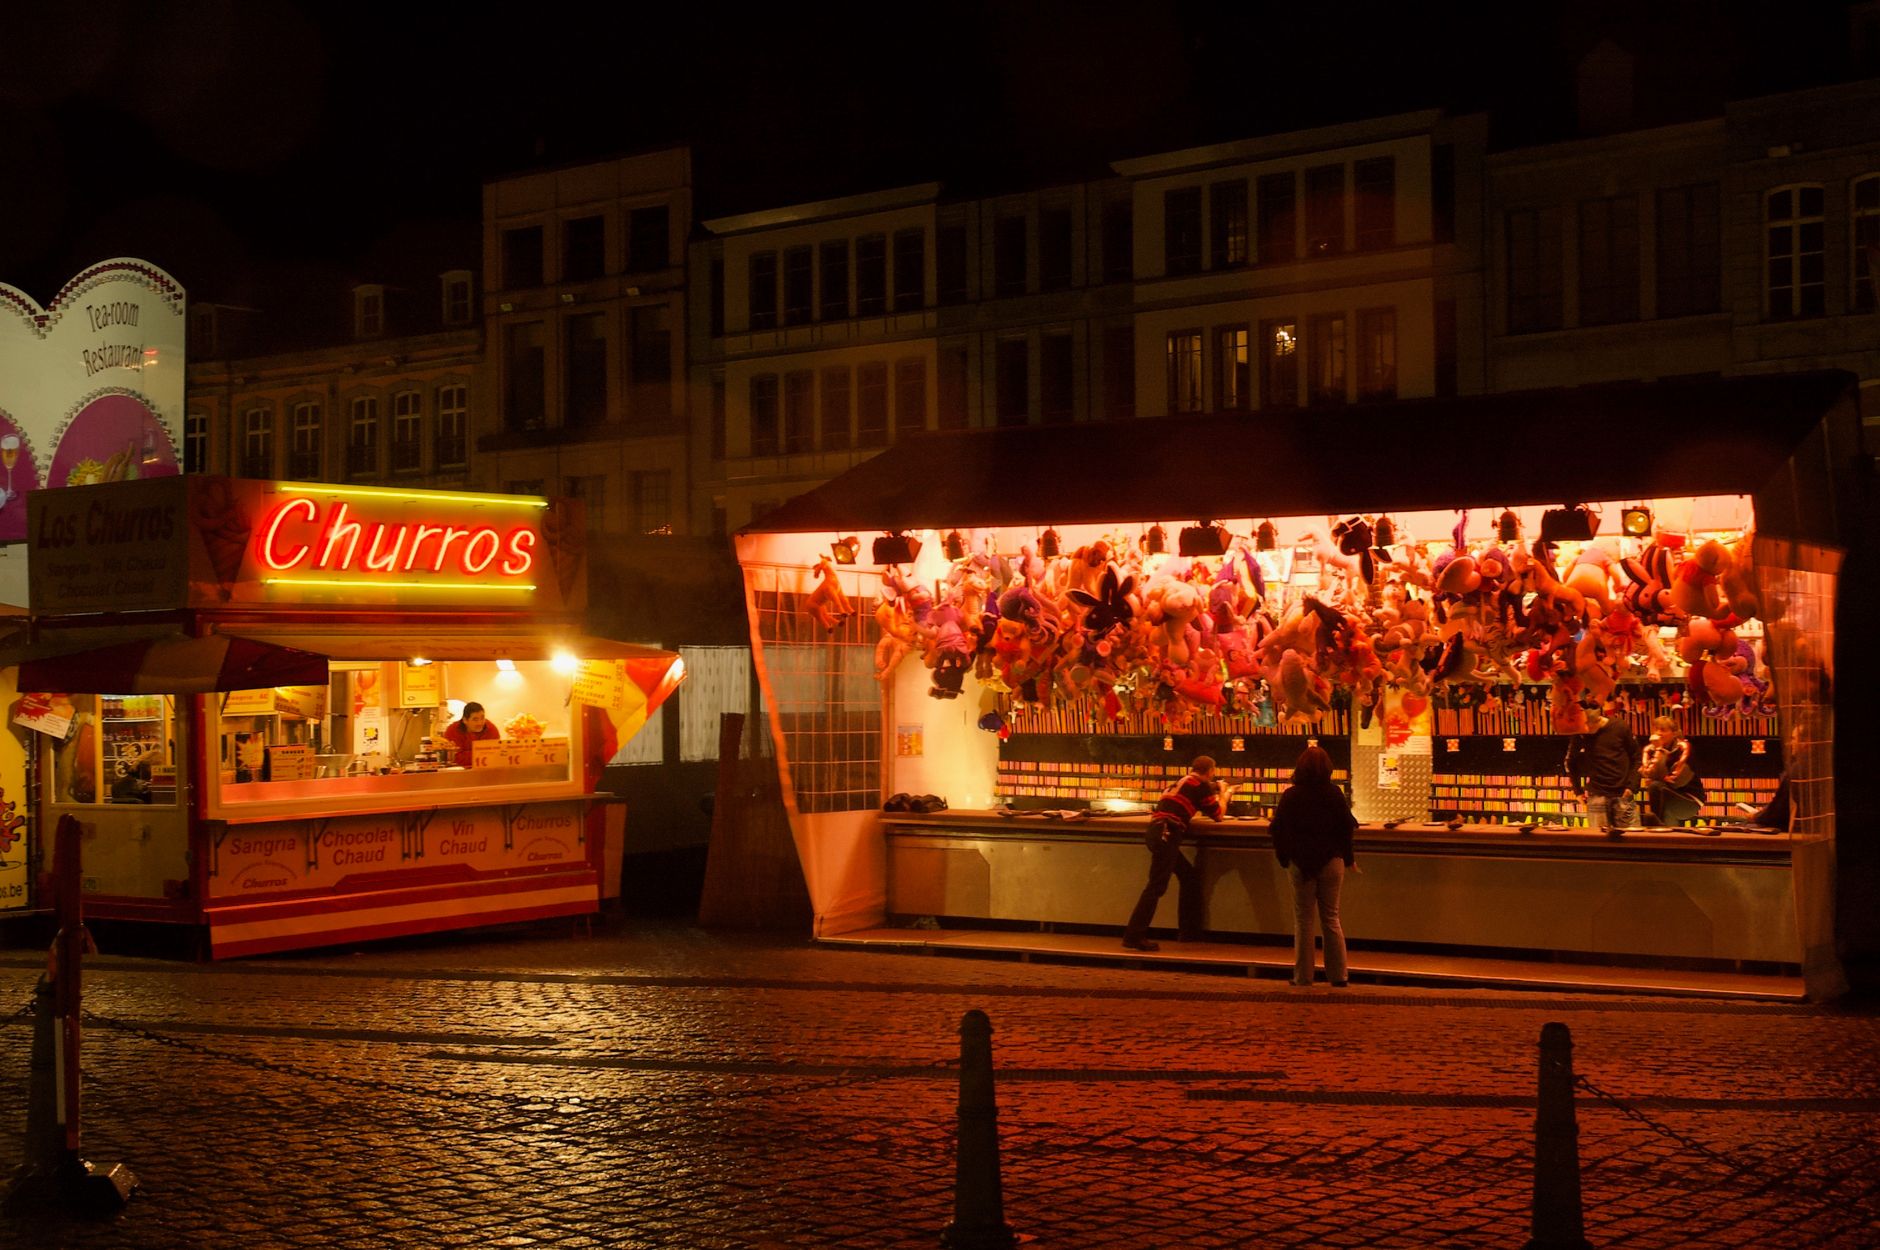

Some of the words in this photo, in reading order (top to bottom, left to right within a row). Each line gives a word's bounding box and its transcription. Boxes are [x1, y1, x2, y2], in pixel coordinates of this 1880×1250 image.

[86, 302, 139, 332] Tea-room
[82, 342, 143, 377] Restaurant
[37, 505, 78, 549] Los
[86, 499, 176, 545] Churros
[260, 498, 536, 575] Churros
[452, 819, 474, 836] Vin
[516, 815, 571, 831] Churros
[230, 838, 296, 857] Sangria
[322, 828, 394, 848] Chocolat
[439, 837, 488, 856] Chaud
[333, 846, 385, 866] Chaud
[242, 877, 288, 889] Churros
